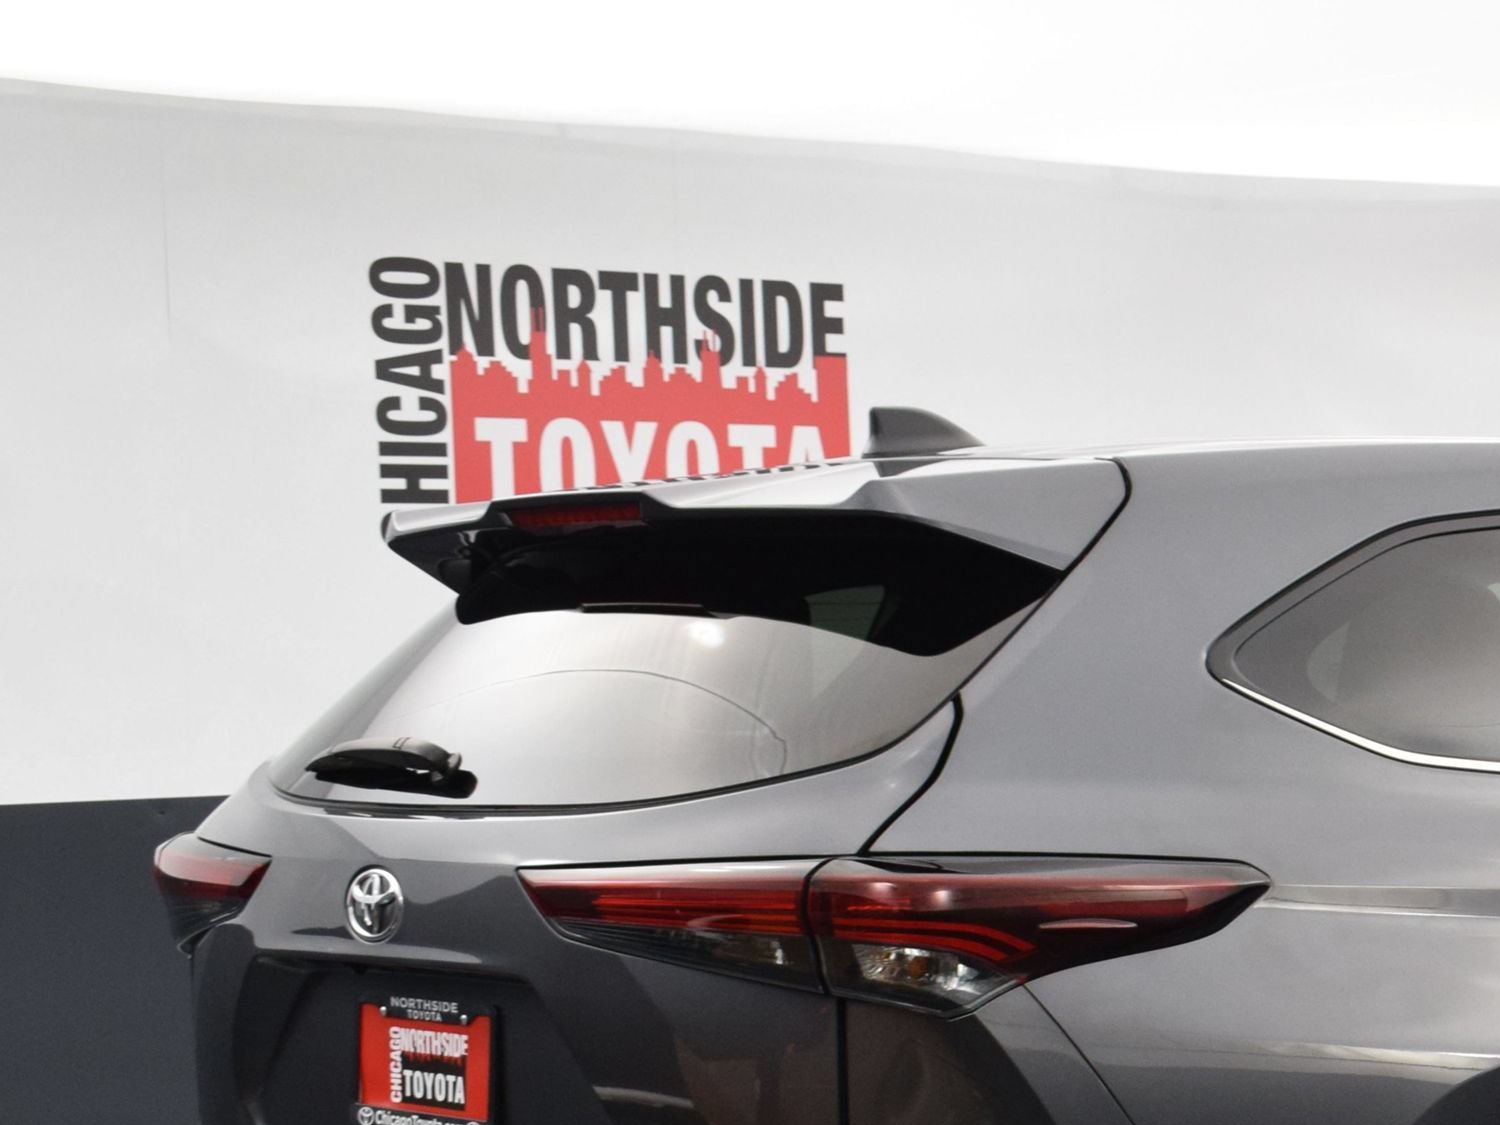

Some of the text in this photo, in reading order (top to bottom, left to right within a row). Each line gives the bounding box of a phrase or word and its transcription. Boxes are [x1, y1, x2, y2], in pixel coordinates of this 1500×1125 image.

[444, 261, 847, 368] NORTHSIDE
[369, 256, 450, 504] HICAGO
[390, 996, 459, 1014] NORTHSIDE
[407, 1009, 442, 1022] TOYOTA
[400, 1028, 469, 1057] NORTHSIDE
[389, 1026, 403, 1103] CHICAGO
[403, 1069, 465, 1104] TOYOTA
